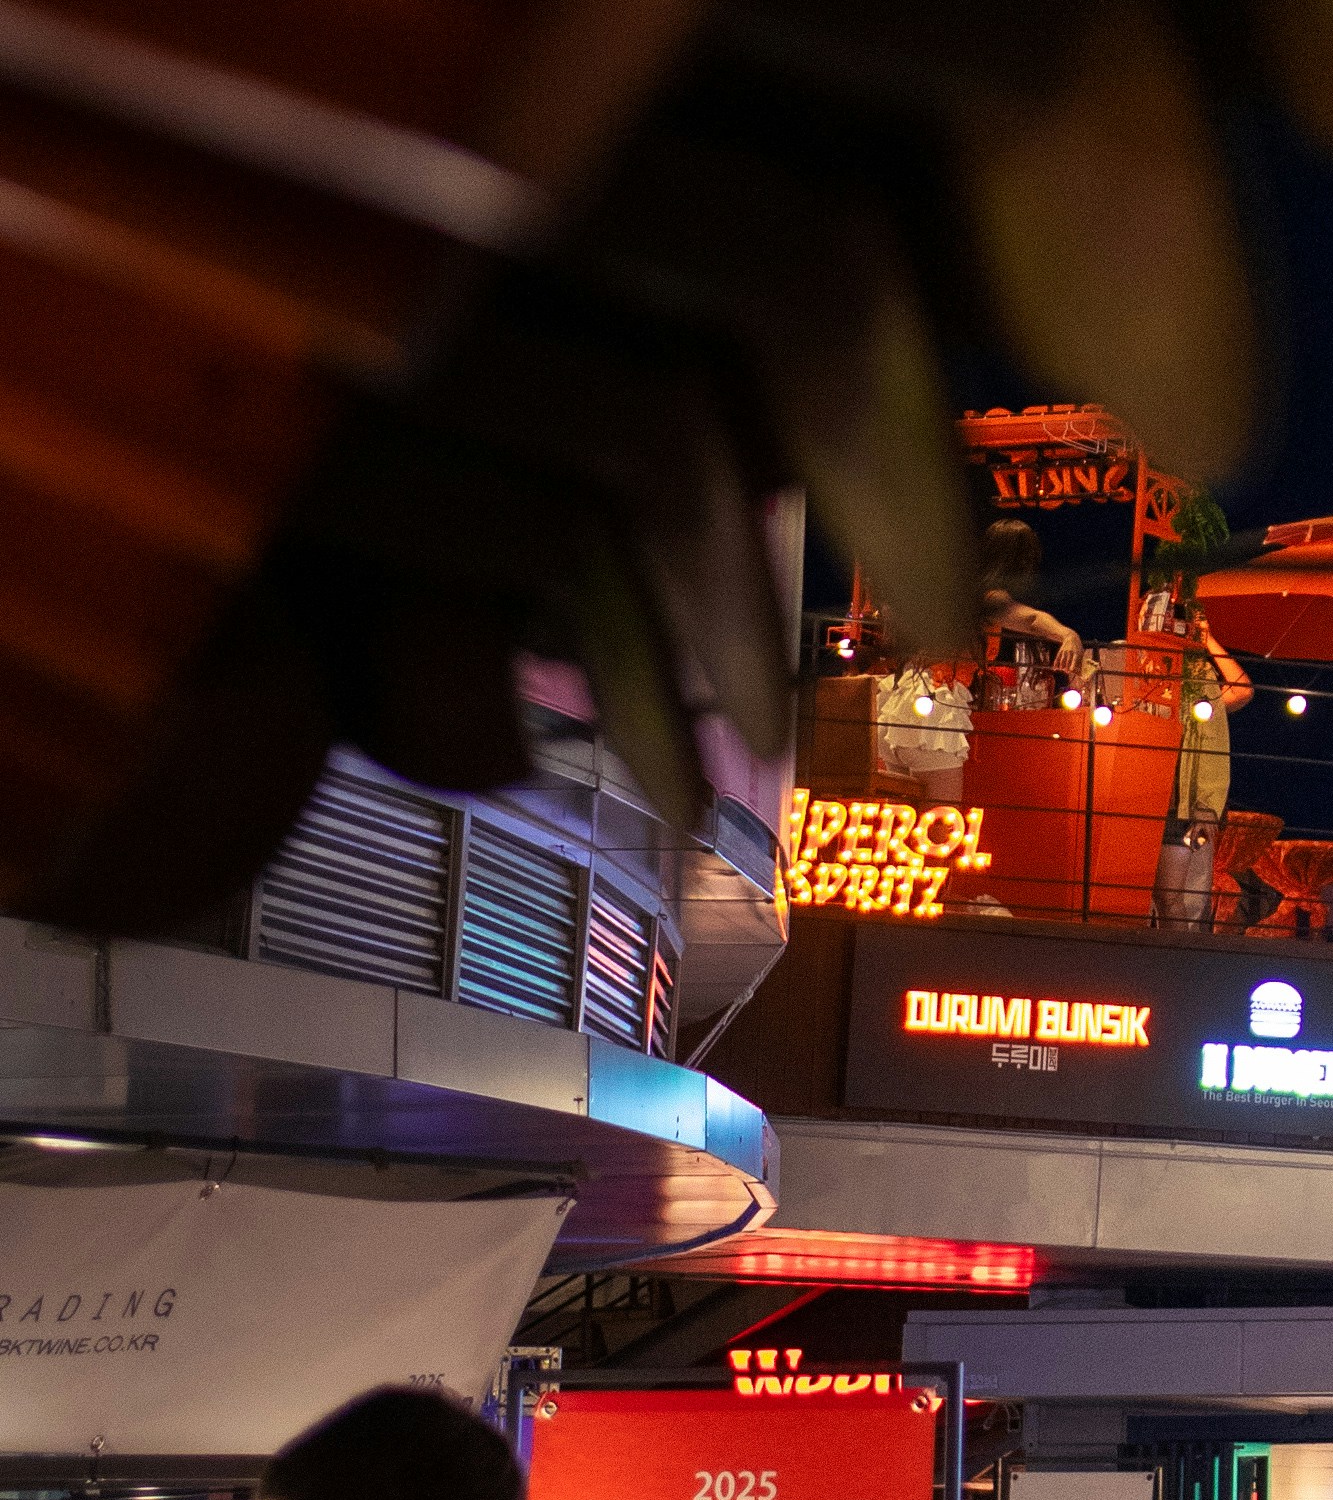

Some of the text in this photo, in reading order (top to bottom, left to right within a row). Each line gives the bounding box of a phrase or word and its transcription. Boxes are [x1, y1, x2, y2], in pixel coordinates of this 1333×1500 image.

[786, 860, 950, 916] SPRITZ
[905, 989, 1151, 1046] DURUMI BUNSIK
[991, 1043, 1047, 1071] 두루미
[1226, 1091, 1251, 1103] Best
[1254, 1094, 1292, 1108] Burger
